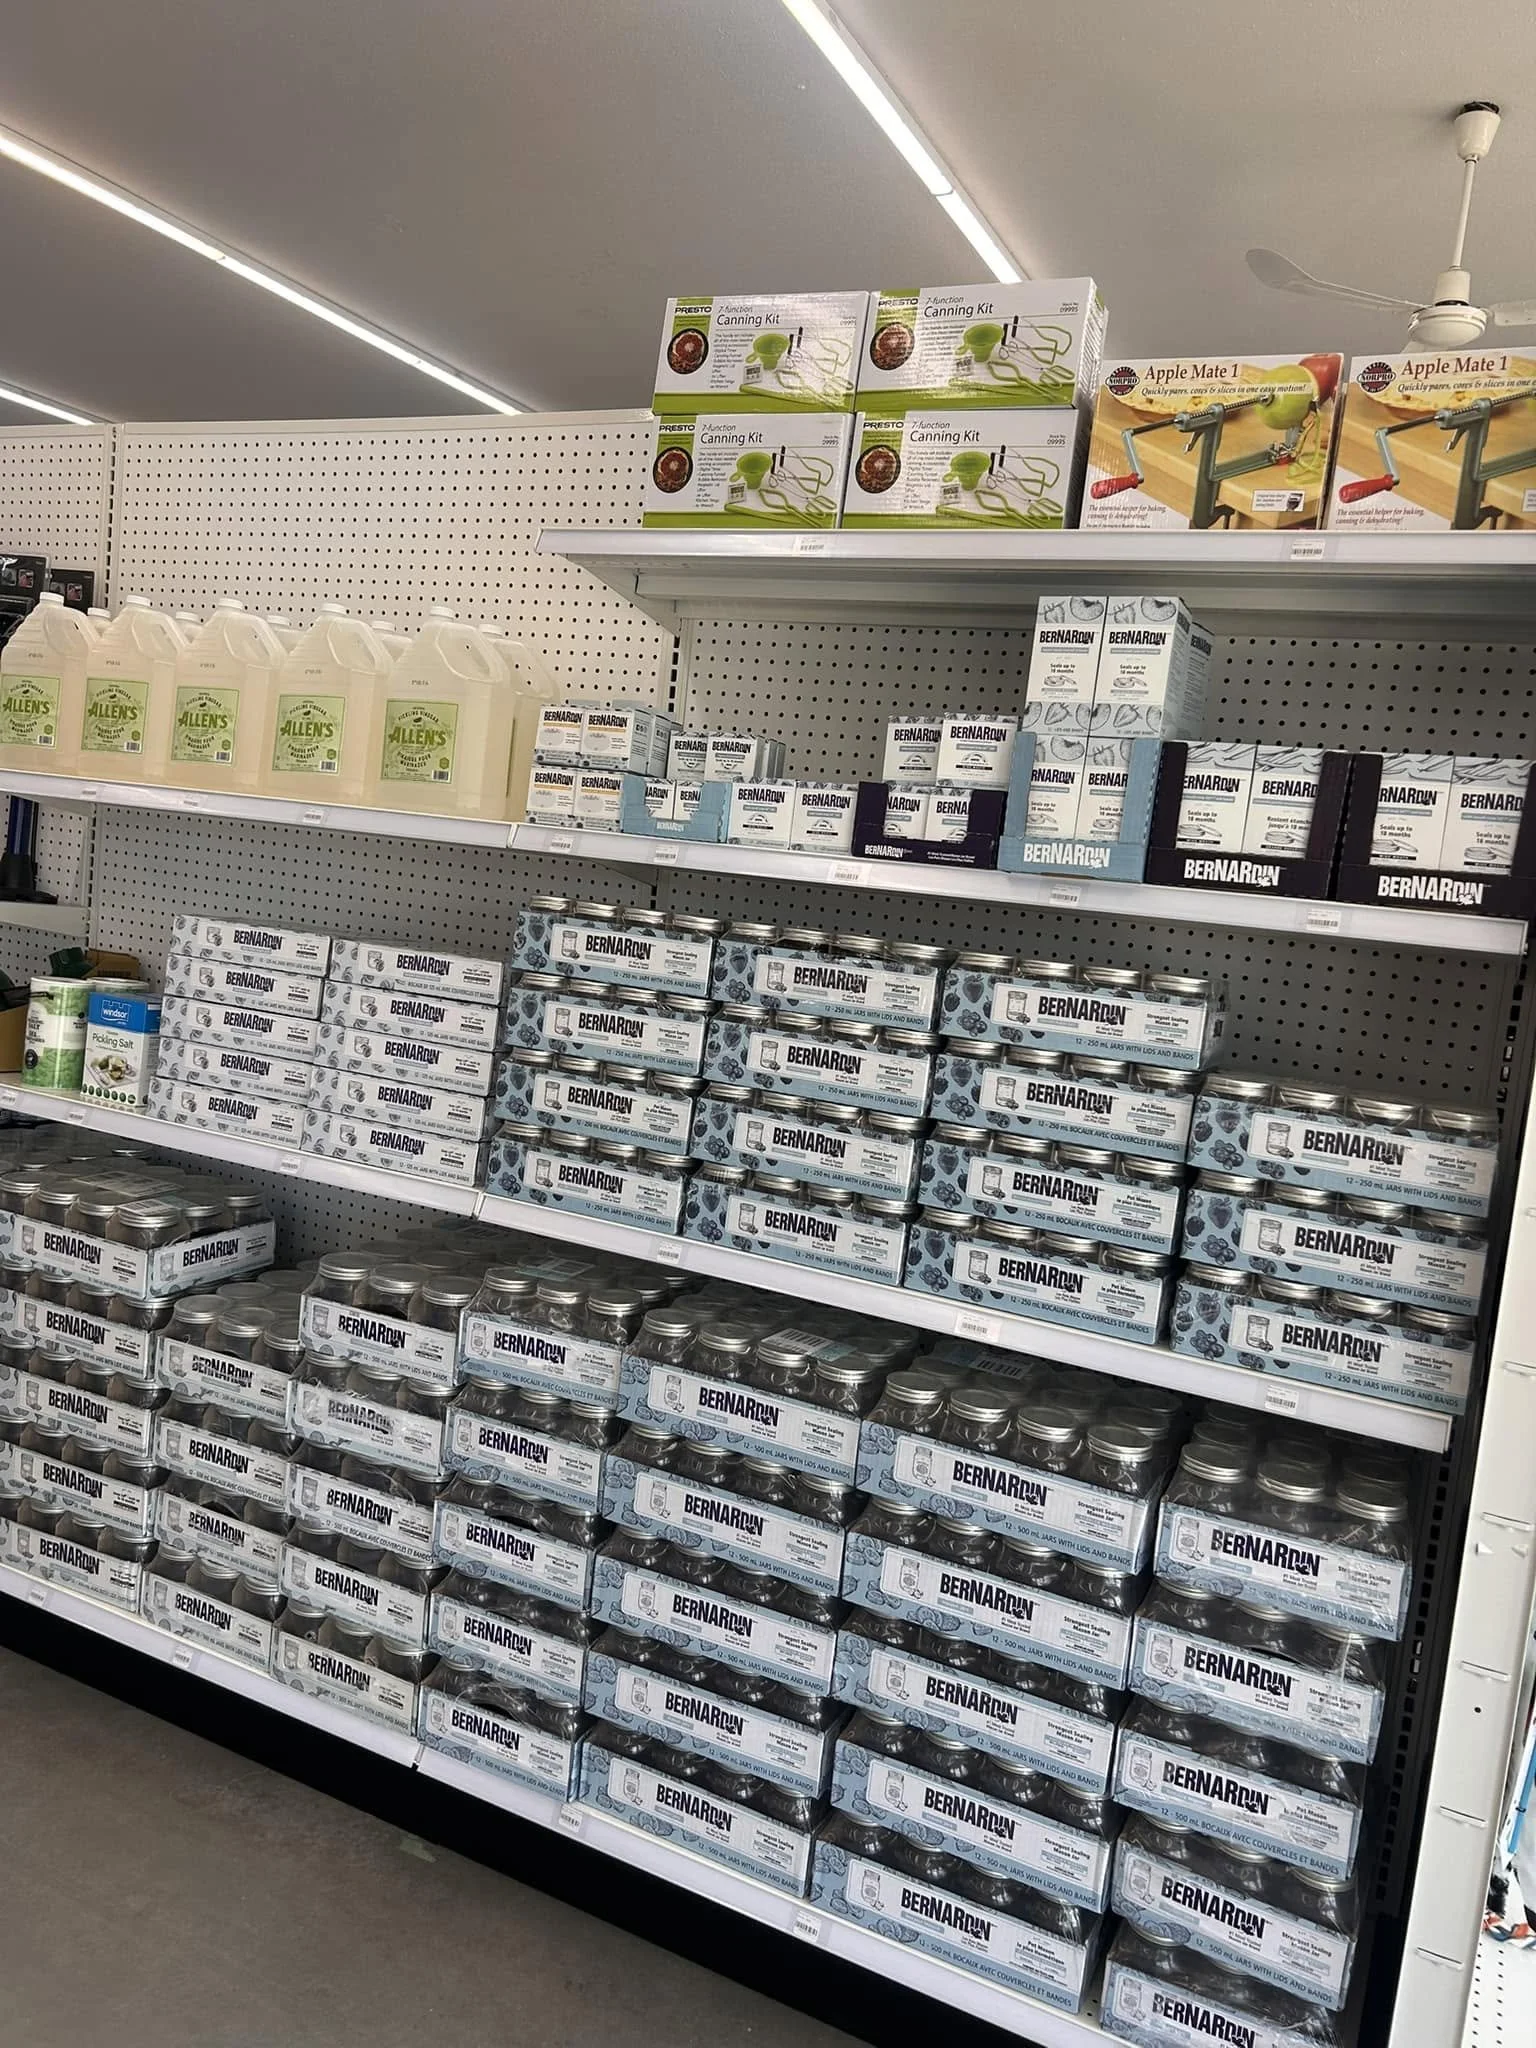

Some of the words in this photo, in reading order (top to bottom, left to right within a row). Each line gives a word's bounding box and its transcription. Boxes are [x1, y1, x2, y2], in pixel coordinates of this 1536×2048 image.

[675, 306, 712, 314] PRESTO
[879, 298, 919, 307] PRESTO
[924, 306, 973, 319] Canning
[978, 303, 993, 314] Kit
[717, 315, 762, 327] Canning
[765, 314, 780, 324] Kit
[1108, 377, 1137, 385] NORPRO
[1144, 364, 1187, 384] Apple
[1191, 364, 1227, 378] Mate
[1232, 364, 1239, 377] 1
[1361, 373, 1393, 382] NORPRO
[1402, 358, 1449, 379] Apple
[1454, 358, 1493, 373] Mate
[1500, 356, 1507, 370] 1
[1141, 387, 1168, 396] Quickly
[1217, 385, 1238, 393] slices
[1260, 386, 1275, 394] easy
[659, 424, 695, 432] PRESTO
[700, 431, 745, 446] Canning
[748, 431, 763, 443] Kit
[863, 421, 904, 430] PRESTO
[910, 430, 961, 444] Canning
[964, 430, 980, 442] Kit
[1375, 509, 1392, 517] helper
[1040, 630, 1094, 644] BERNARDIN
[1109, 630, 1166, 645] BERNARDIN
[3, 697, 50, 715] ALLEN'S
[88, 701, 137, 720] ALLEN'S
[544, 710, 582, 724] BERNARDIN
[178, 711, 228, 729] ALLEN'S
[280, 720, 334, 738] ALLEN'S
[588, 714, 627, 727] BERNARDIN
[950, 726, 1006, 741] BERNARDIN
[389, 726, 446, 746] ALLEN'S
[712, 741, 751, 753] BERNARDIN
[534, 773, 573, 786] BERNARDIN
[581, 776, 620, 790] BERNARDIN
[738, 789, 784, 803] BERNARDIN
[802, 794, 850, 808] BERNARDIN
[865, 845, 903, 858] BERNARDIN
[1024, 843, 1110, 868] BERNARDIN
[1184, 859, 1280, 887] BERNARDIN
[1378, 875, 1483, 905] BERNARDIN
[234, 930, 282, 950] BERNARDIN
[585, 935, 651, 960] BERNARDIN
[397, 954, 450, 975] BERNARDIN
[226, 971, 274, 992] BERNARDIN
[793, 966, 867, 993] BERNARDIN
[103, 1009, 128, 1018] windsor
[224, 1011, 273, 1032] BERNARDIN
[390, 1000, 445, 1022] BERNARDIN
[1038, 996, 1126, 1026] BERNARDIN
[578, 1013, 644, 1038] BERNARDIN
[93, 1033, 117, 1048] Pickling
[119, 1039, 134, 1049] Salt
[385, 1041, 439, 1064] BERNARDIN
[221, 1054, 270, 1075] BERNARDIN
[787, 1046, 861, 1075] BERNARDIN
[208, 1097, 258, 1119] BERNARDIN
[378, 1086, 432, 1110] BERNARDIN
[568, 1087, 633, 1114] BERNARDIN
[1027, 1083, 1113, 1114] BERNARDIN
[370, 1130, 424, 1154] BERNARDIN
[773, 1127, 846, 1158] BERNARDIN
[1303, 1129, 1404, 1165] BERNARDIN
[558, 1164, 624, 1193] BERNARDIN
[1013, 1173, 1099, 1206] BERNARDIN
[764, 1209, 837, 1241] BERNARDIN
[44, 1232, 100, 1264] BERNARDIN
[183, 1239, 239, 1267] BERNARDIN
[1294, 1226, 1395, 1264] BERNARDIN
[999, 1258, 1083, 1294] BERNARDIN
[46, 1311, 105, 1345] BERNARDIN
[339, 1314, 406, 1349] BERNARDIN
[494, 1331, 565, 1364] BERNARDIN
[1282, 1323, 1382, 1363] BERNARDIN
[49, 1389, 107, 1426] BERNARDIN
[699, 1387, 779, 1426] BERNARDIN
[189, 1440, 249, 1473] BERNARDIN
[479, 1427, 548, 1464] BERNARDIN
[43, 1463, 102, 1498] BERNARDIN
[953, 1460, 1047, 1506] BERNARDIN
[326, 1488, 393, 1526] BERNARDIN
[684, 1494, 763, 1537] BERNARDIN
[466, 1523, 535, 1562] BERNARDIN
[1005, 1522, 1012, 1530] 12
[1018, 1526, 1030, 1535] 500
[1041, 1534, 1057, 1544] JARS
[1058, 1538, 1075, 1549] WITH
[1076, 1543, 1090, 1553] LIDS
[1092, 1548, 1107, 1558] AND
[1211, 1529, 1320, 1576] BERNARDIN
[40, 1539, 100, 1574] BERNARDIN
[314, 1567, 379, 1606] BERNARDIN
[940, 1573, 1034, 1620] BERNARDIN
[175, 1594, 231, 1630] BERNARDIN
[673, 1594, 752, 1637] BERNARDIN
[464, 1615, 532, 1656] BERNARDIN
[308, 1652, 370, 1692] BERNARDIN
[1184, 1646, 1291, 1698] BERNARDIN
[665, 1691, 744, 1736] BERNARDIN
[926, 1676, 1018, 1725] BERNARDIN
[452, 1709, 519, 1750] BERNARDIN
[1163, 1761, 1269, 1815] BERNARDIN
[656, 1783, 732, 1832] BERNARDIN
[924, 1787, 1015, 1839] BERNARDIN
[1161, 1807, 1169, 1817] 12
[1175, 1812, 1188, 1822] 500
[1201, 1821, 1231, 1836] BOCAUX
[1232, 1830, 1250, 1844] AVEC
[1252, 1839, 1298, 1861] COUVERCLES
[1300, 1855, 1309, 1864] ET
[1310, 1858, 1339, 1875] BANDES
[901, 1888, 991, 1941] BERNARDIN
[1161, 1876, 1265, 1938] BERNARDIN
[1152, 1993, 1255, 2048] BERNARDIN
